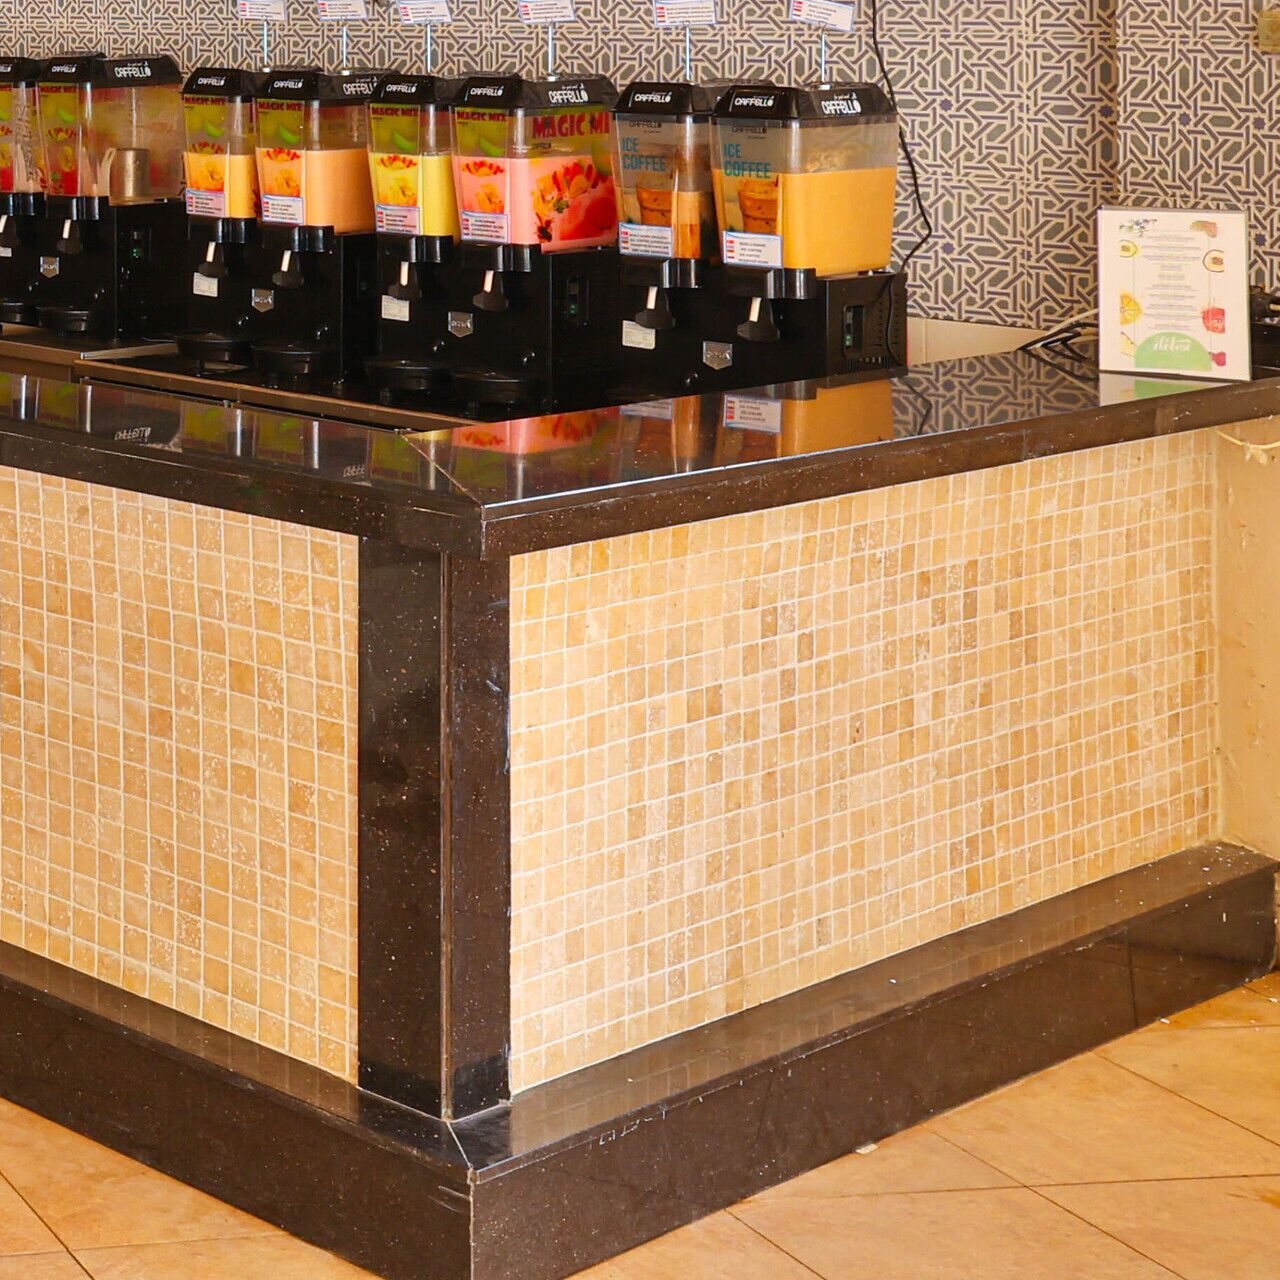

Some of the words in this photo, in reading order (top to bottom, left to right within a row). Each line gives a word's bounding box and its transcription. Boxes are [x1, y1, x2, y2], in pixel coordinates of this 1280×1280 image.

[532, 114, 586, 138] MAGIC
[622, 137, 639, 152] ICE
[724, 143, 741, 158] ICE
[622, 155, 666, 171] COFFEE
[724, 160, 771, 179] COFFEE
